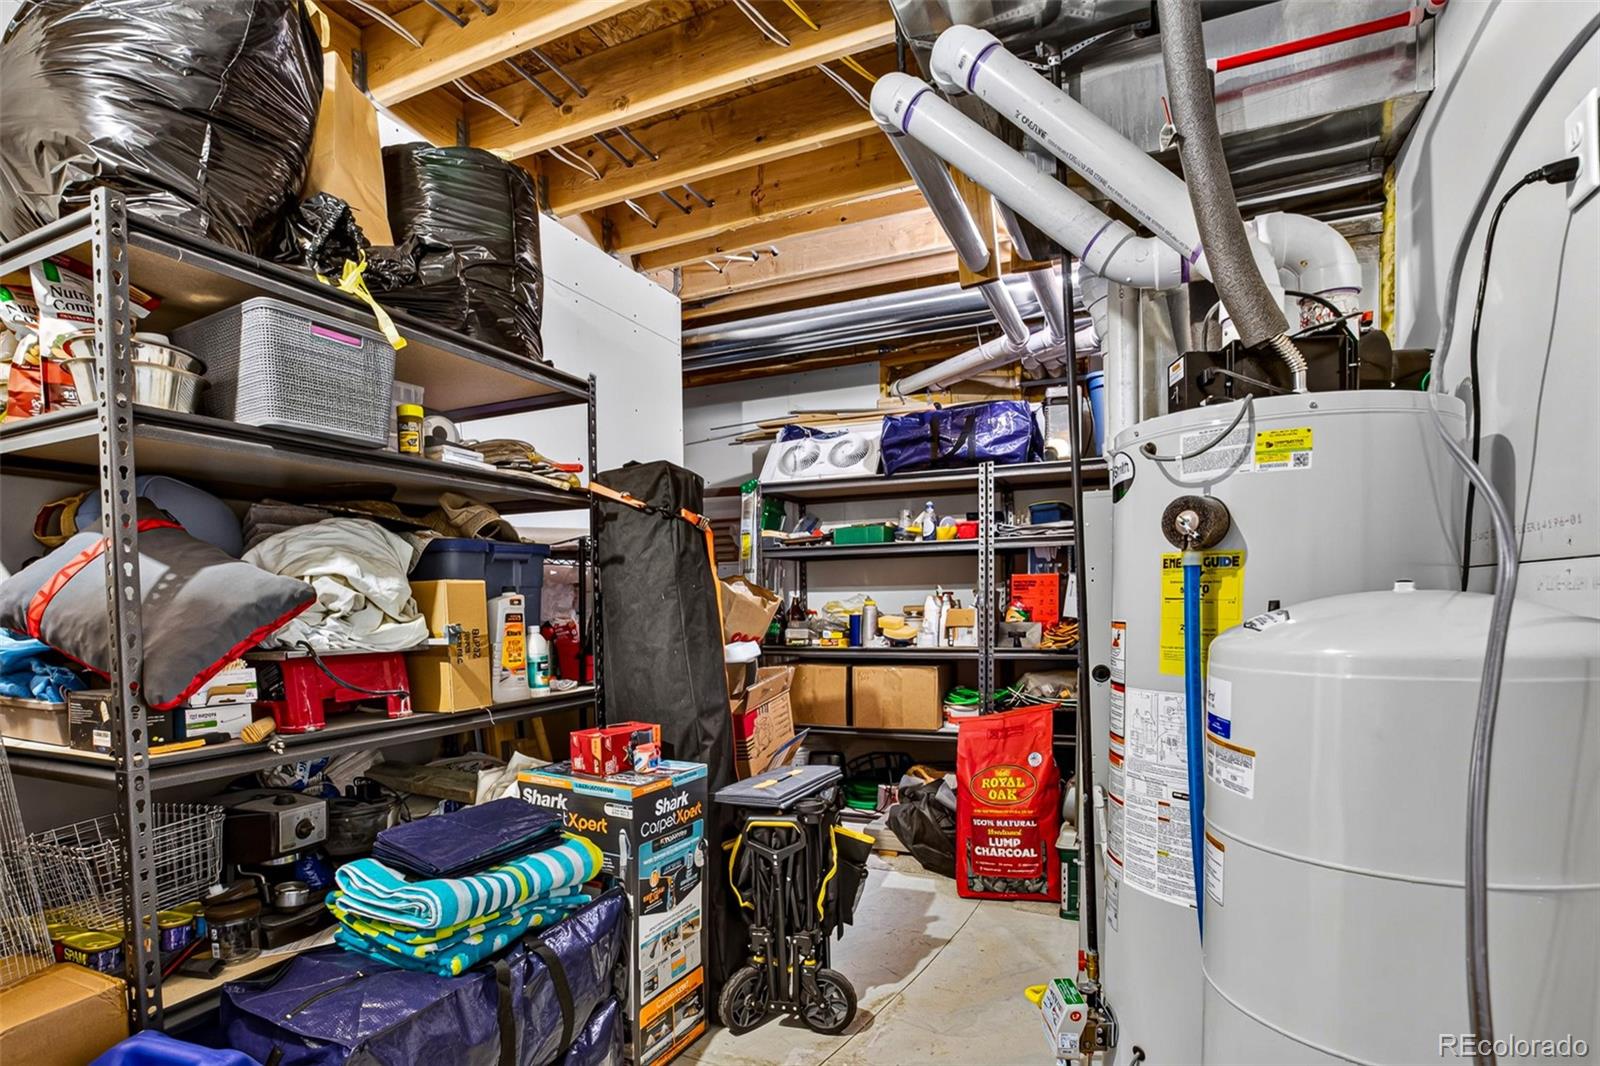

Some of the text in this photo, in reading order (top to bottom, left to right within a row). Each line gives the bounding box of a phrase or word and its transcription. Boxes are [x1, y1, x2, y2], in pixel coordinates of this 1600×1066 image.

[981, 777, 1026, 789] ROYAL
[522, 787, 568, 811] Shark
[988, 789, 1018, 801] OAK
[655, 790, 690, 817] Shark
[996, 819, 1037, 828] NATURAL
[988, 837, 1021, 848] LUMP
[974, 845, 1038, 858] CHARCOAL
[63, 947, 88, 965] SPAM
